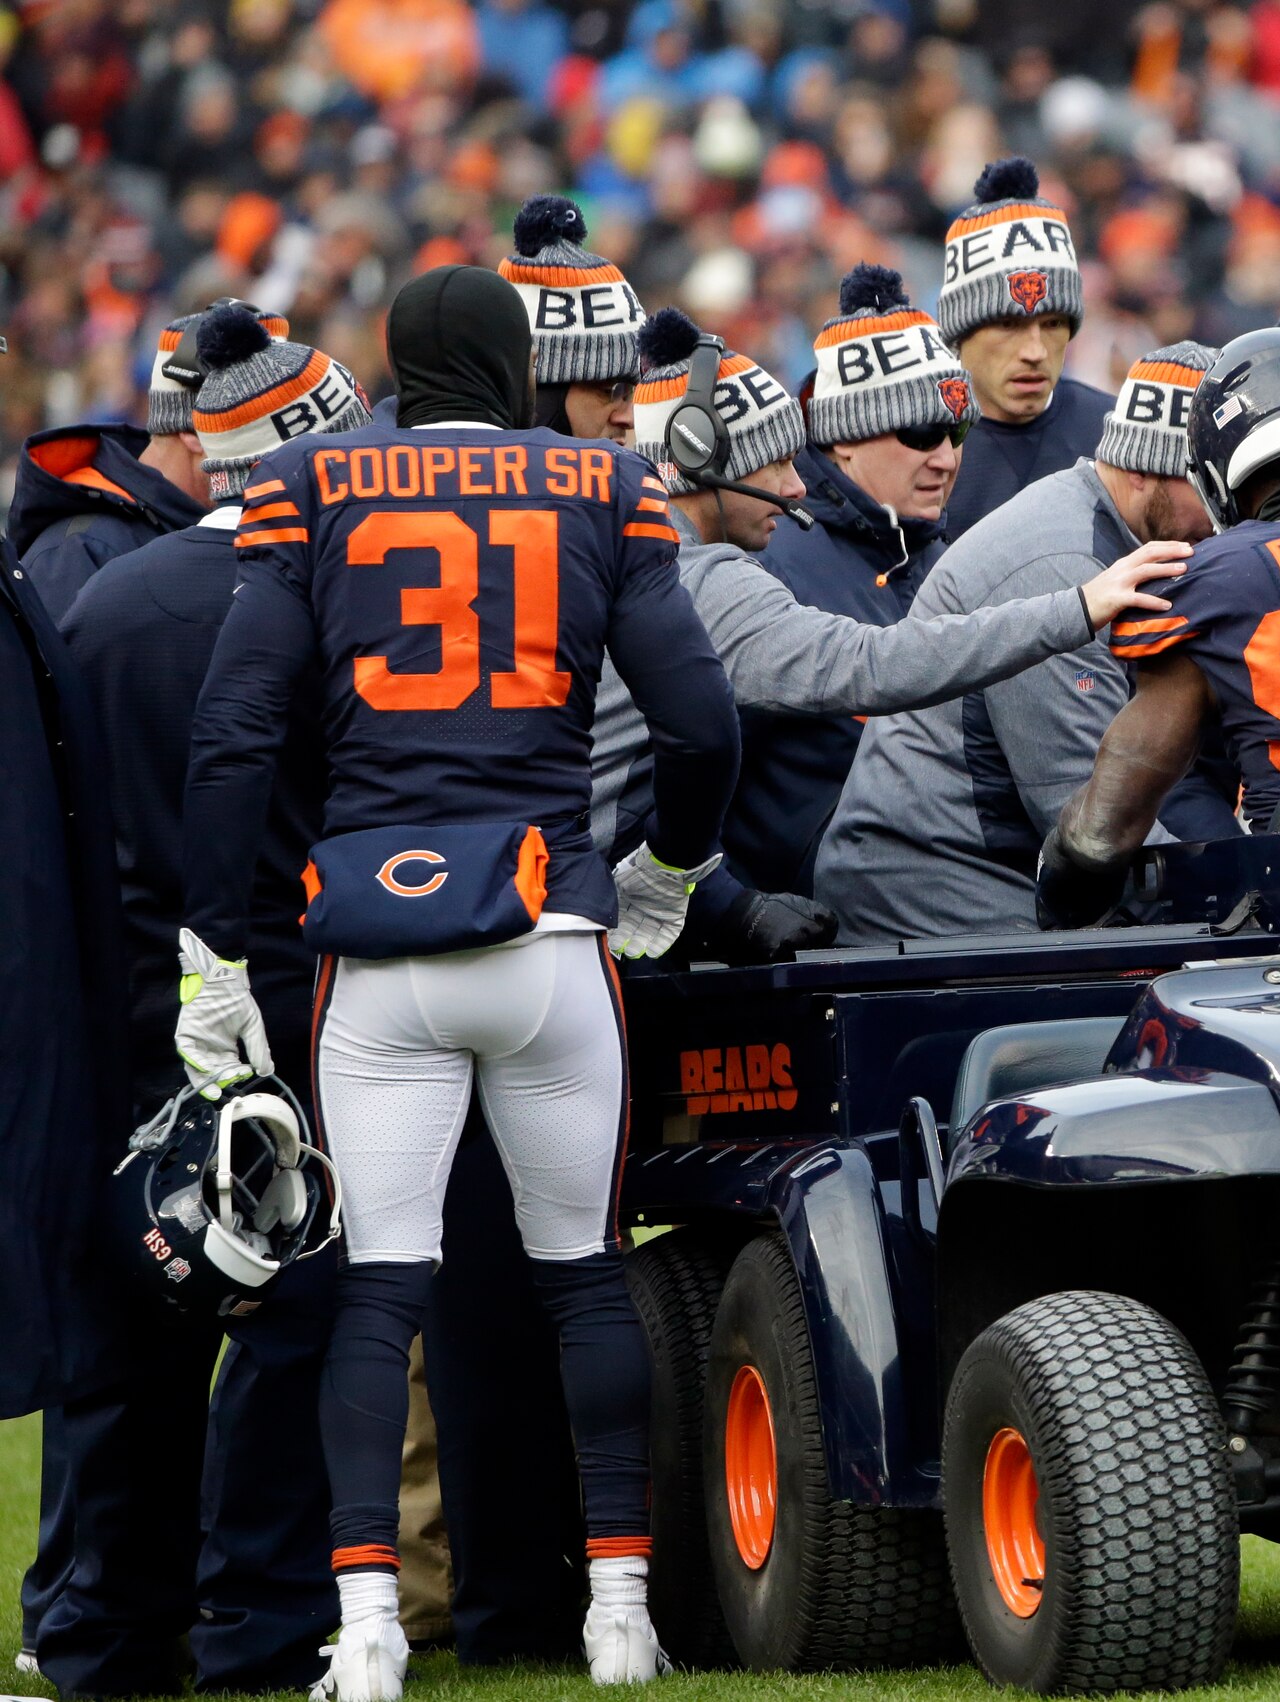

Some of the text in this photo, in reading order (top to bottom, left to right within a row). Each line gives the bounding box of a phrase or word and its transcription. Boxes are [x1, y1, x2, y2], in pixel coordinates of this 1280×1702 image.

[163, 365, 200, 379] BOSE
[673, 422, 711, 452] BOSE
[314, 445, 612, 505] COOPER SR
[789, 508, 814, 527] BOSE
[347, 510, 572, 711] 31
[680, 1043, 798, 1116] BEARS
[143, 1227, 172, 1262] GSH
